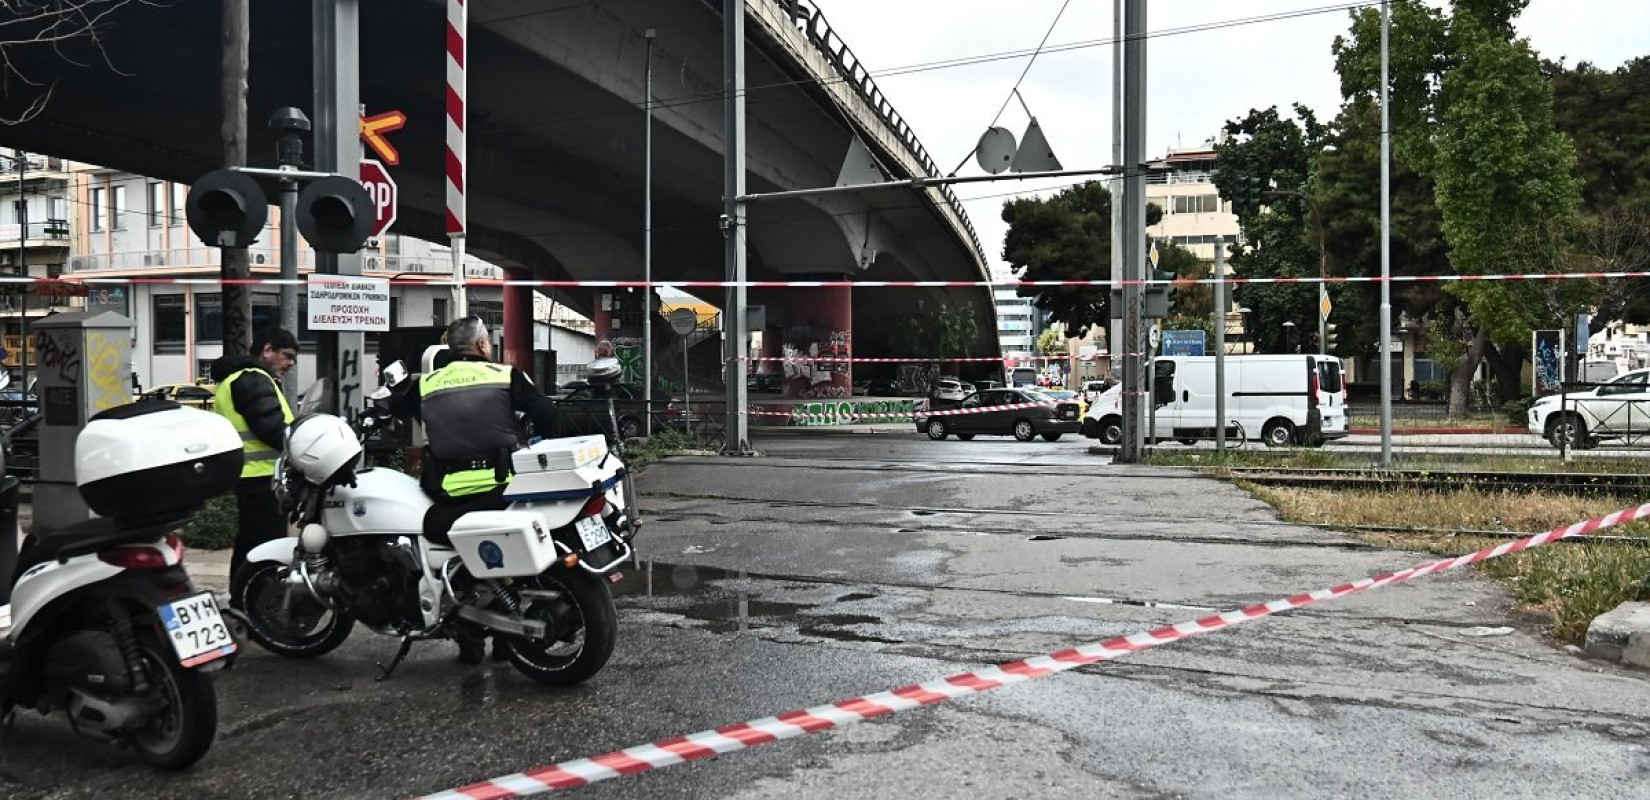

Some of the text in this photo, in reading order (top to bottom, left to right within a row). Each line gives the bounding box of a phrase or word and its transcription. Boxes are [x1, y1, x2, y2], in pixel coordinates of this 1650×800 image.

[330, 304, 370, 314] ΠΡΟΣΟΧΗ
[312, 314, 387, 325] ΔΙΕΛΕΥΣΗ ΤΡΕΝΩΝ
[443, 376, 477, 386] POLICE
[186, 622, 227, 650] 723
